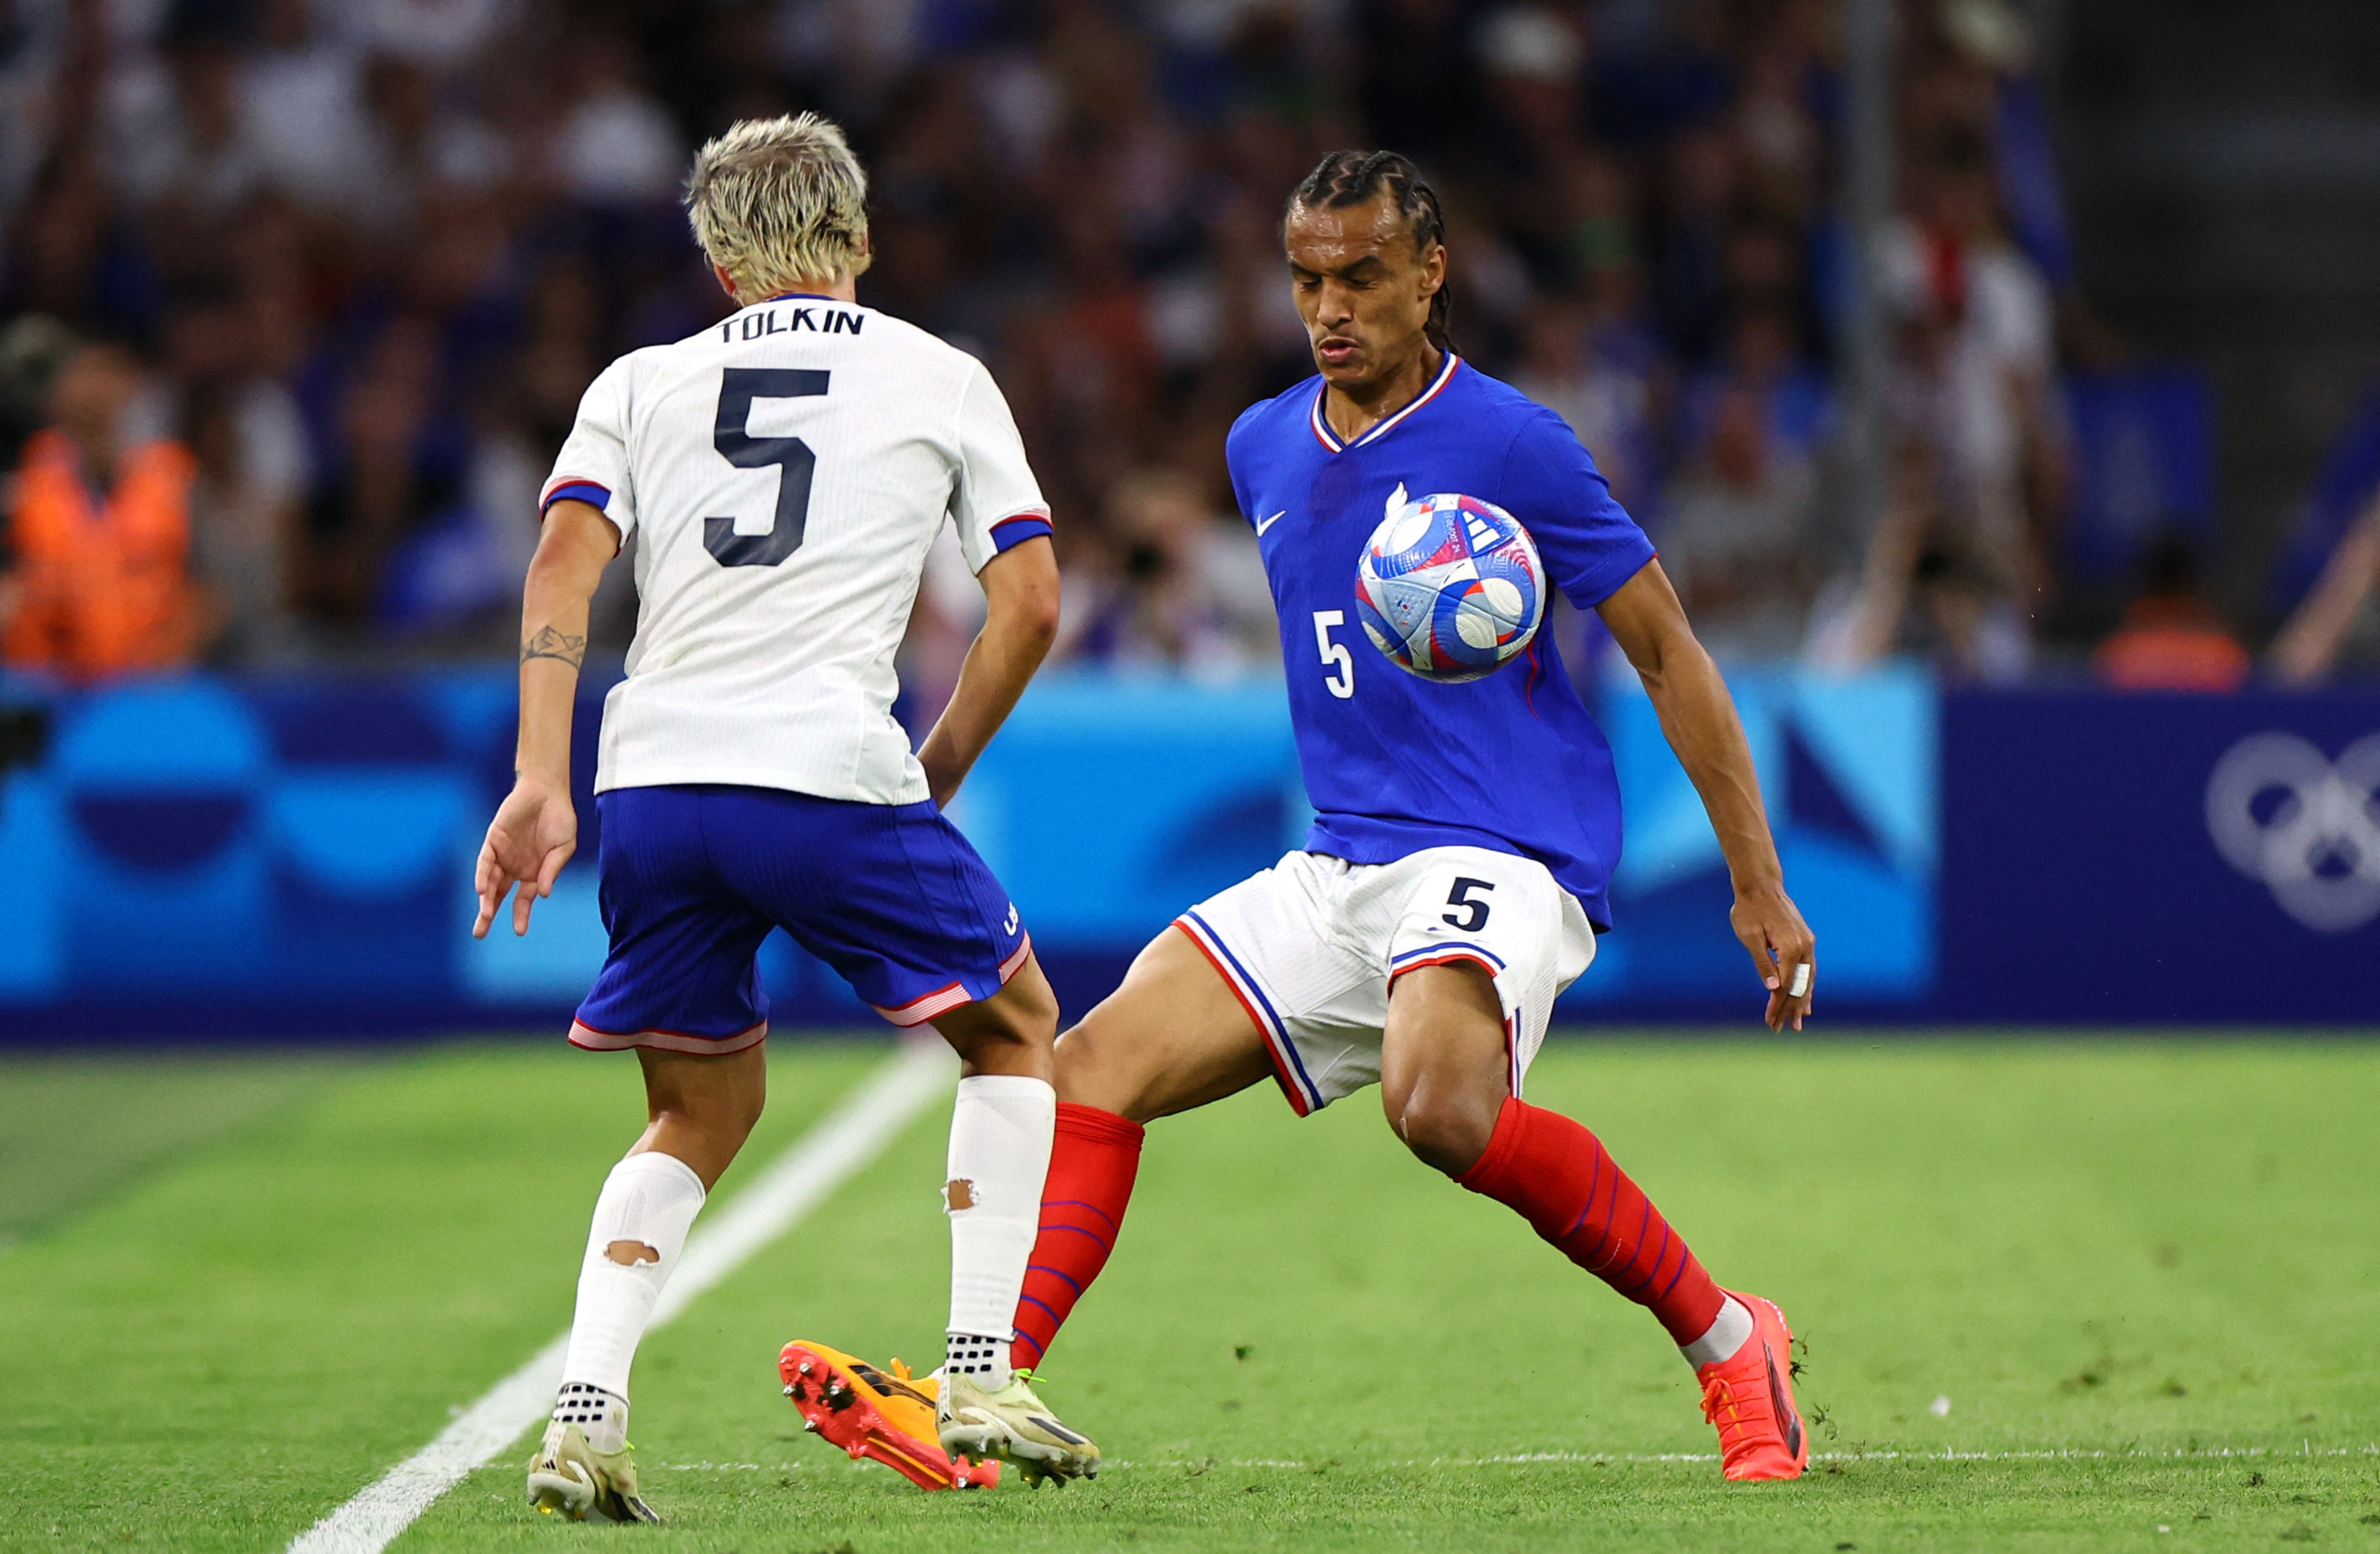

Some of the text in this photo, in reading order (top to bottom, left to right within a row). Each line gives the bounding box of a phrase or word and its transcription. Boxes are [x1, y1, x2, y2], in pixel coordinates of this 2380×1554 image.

[715, 307, 865, 343] TOLKIN
[704, 367, 831, 568] 5
[1313, 610, 1354, 699] 5
[1442, 877, 1496, 932] 5
